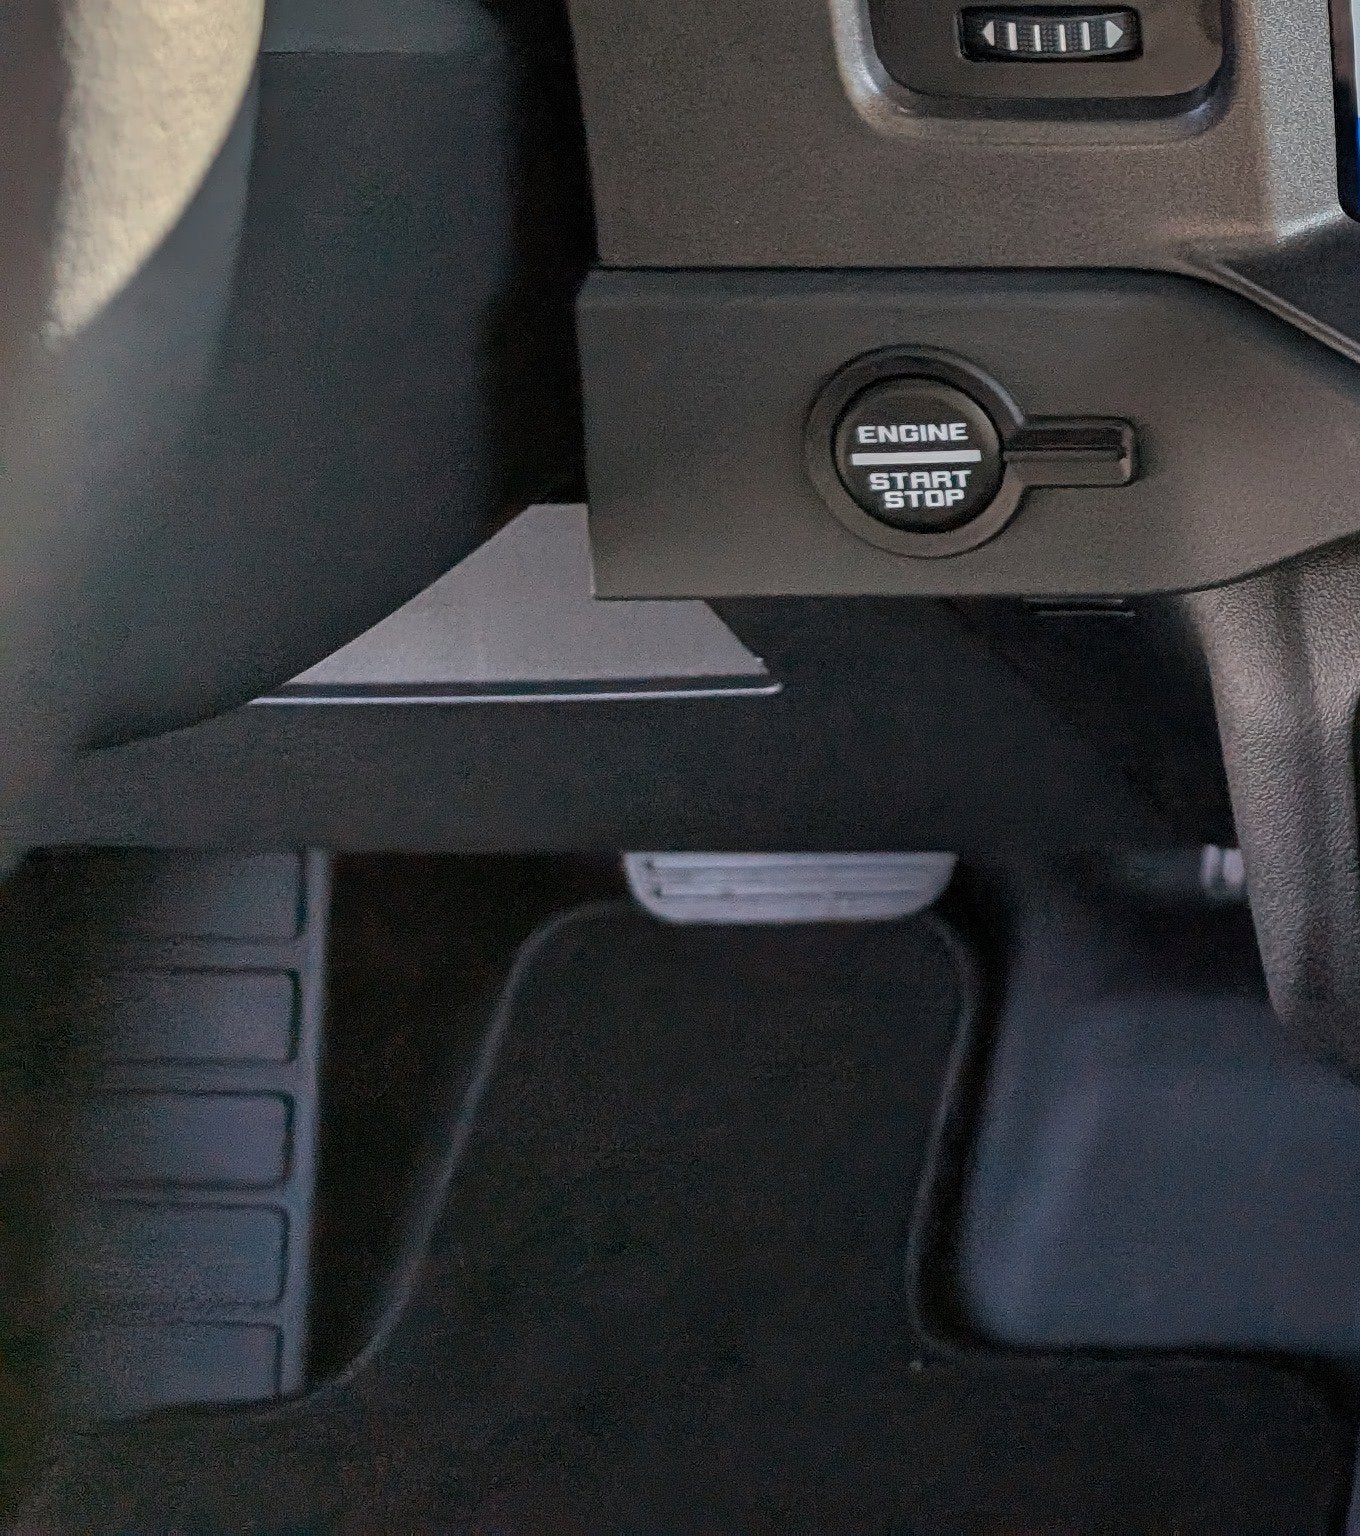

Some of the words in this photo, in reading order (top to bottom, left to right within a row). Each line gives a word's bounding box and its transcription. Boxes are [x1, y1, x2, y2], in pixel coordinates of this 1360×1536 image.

[857, 423, 969, 444] ENGINE
[870, 470, 972, 490] START
[884, 490, 964, 509] STOP
